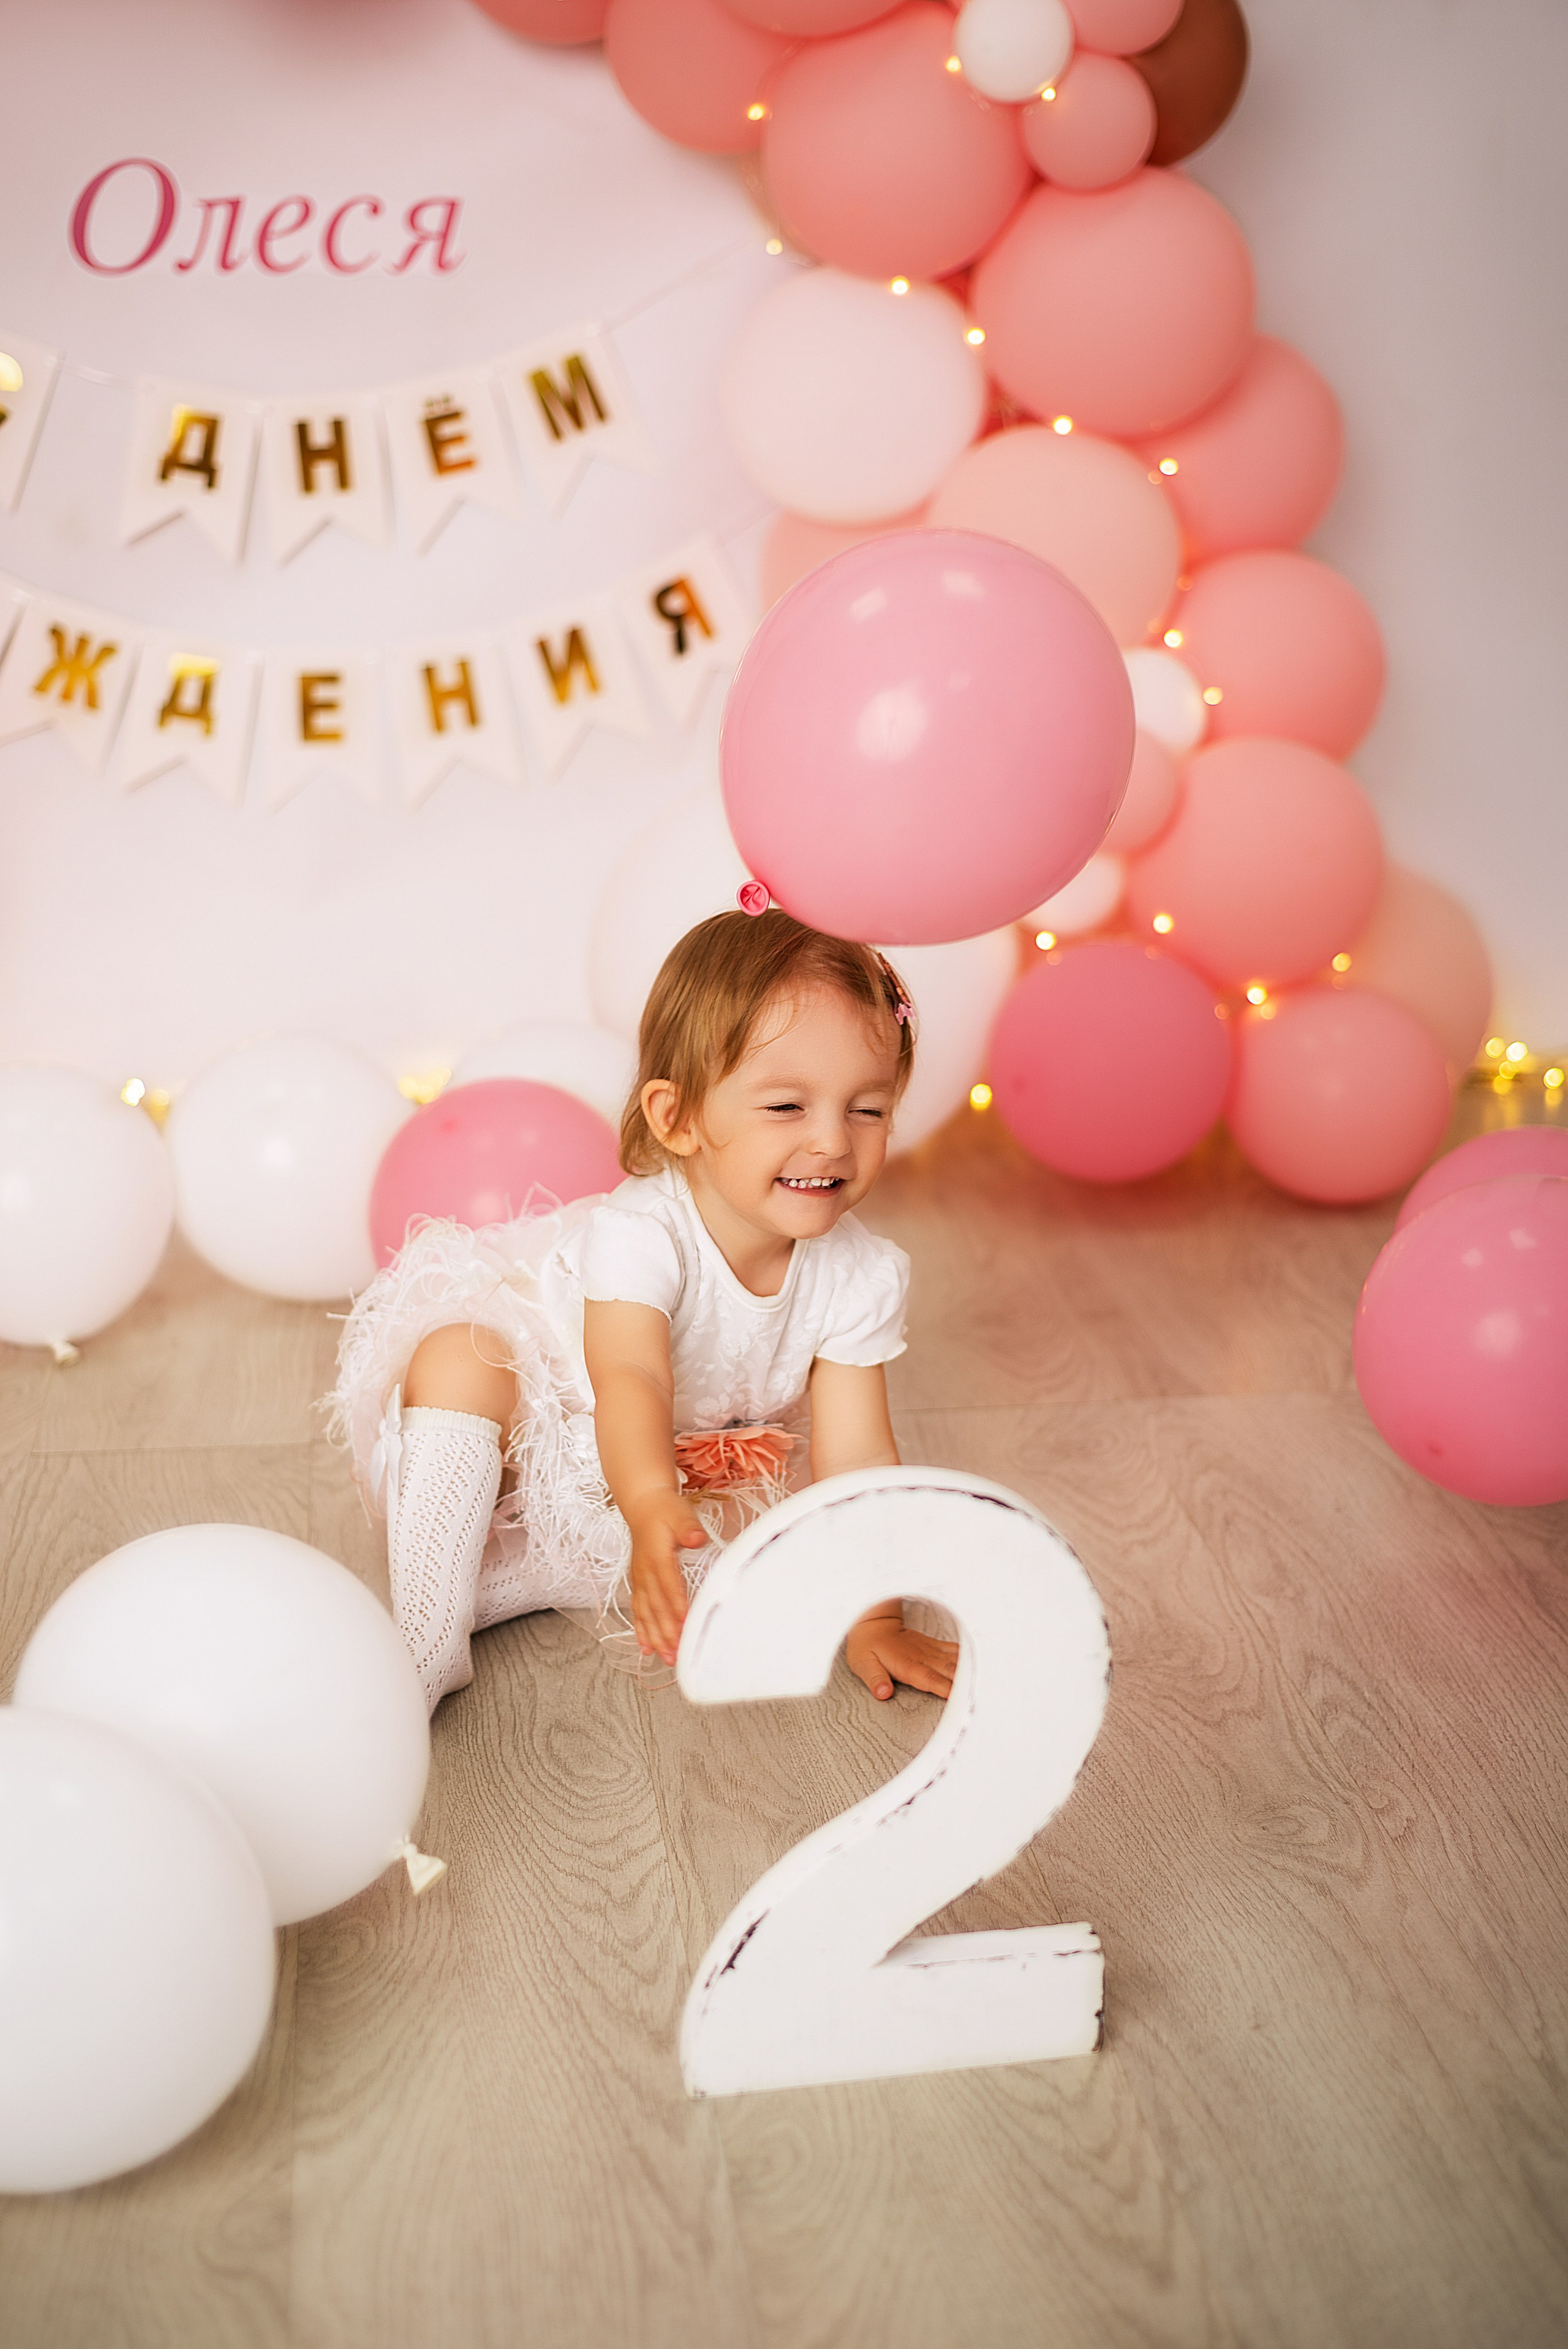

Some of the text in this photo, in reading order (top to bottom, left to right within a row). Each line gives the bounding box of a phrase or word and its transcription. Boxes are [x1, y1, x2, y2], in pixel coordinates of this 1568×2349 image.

[69, 158, 466, 276] Олеся
[159, 353, 610, 494] ДНЁМ
[34, 576, 715, 741] ЖДЕНИЯ
[679, 1465, 1110, 2097] 2
